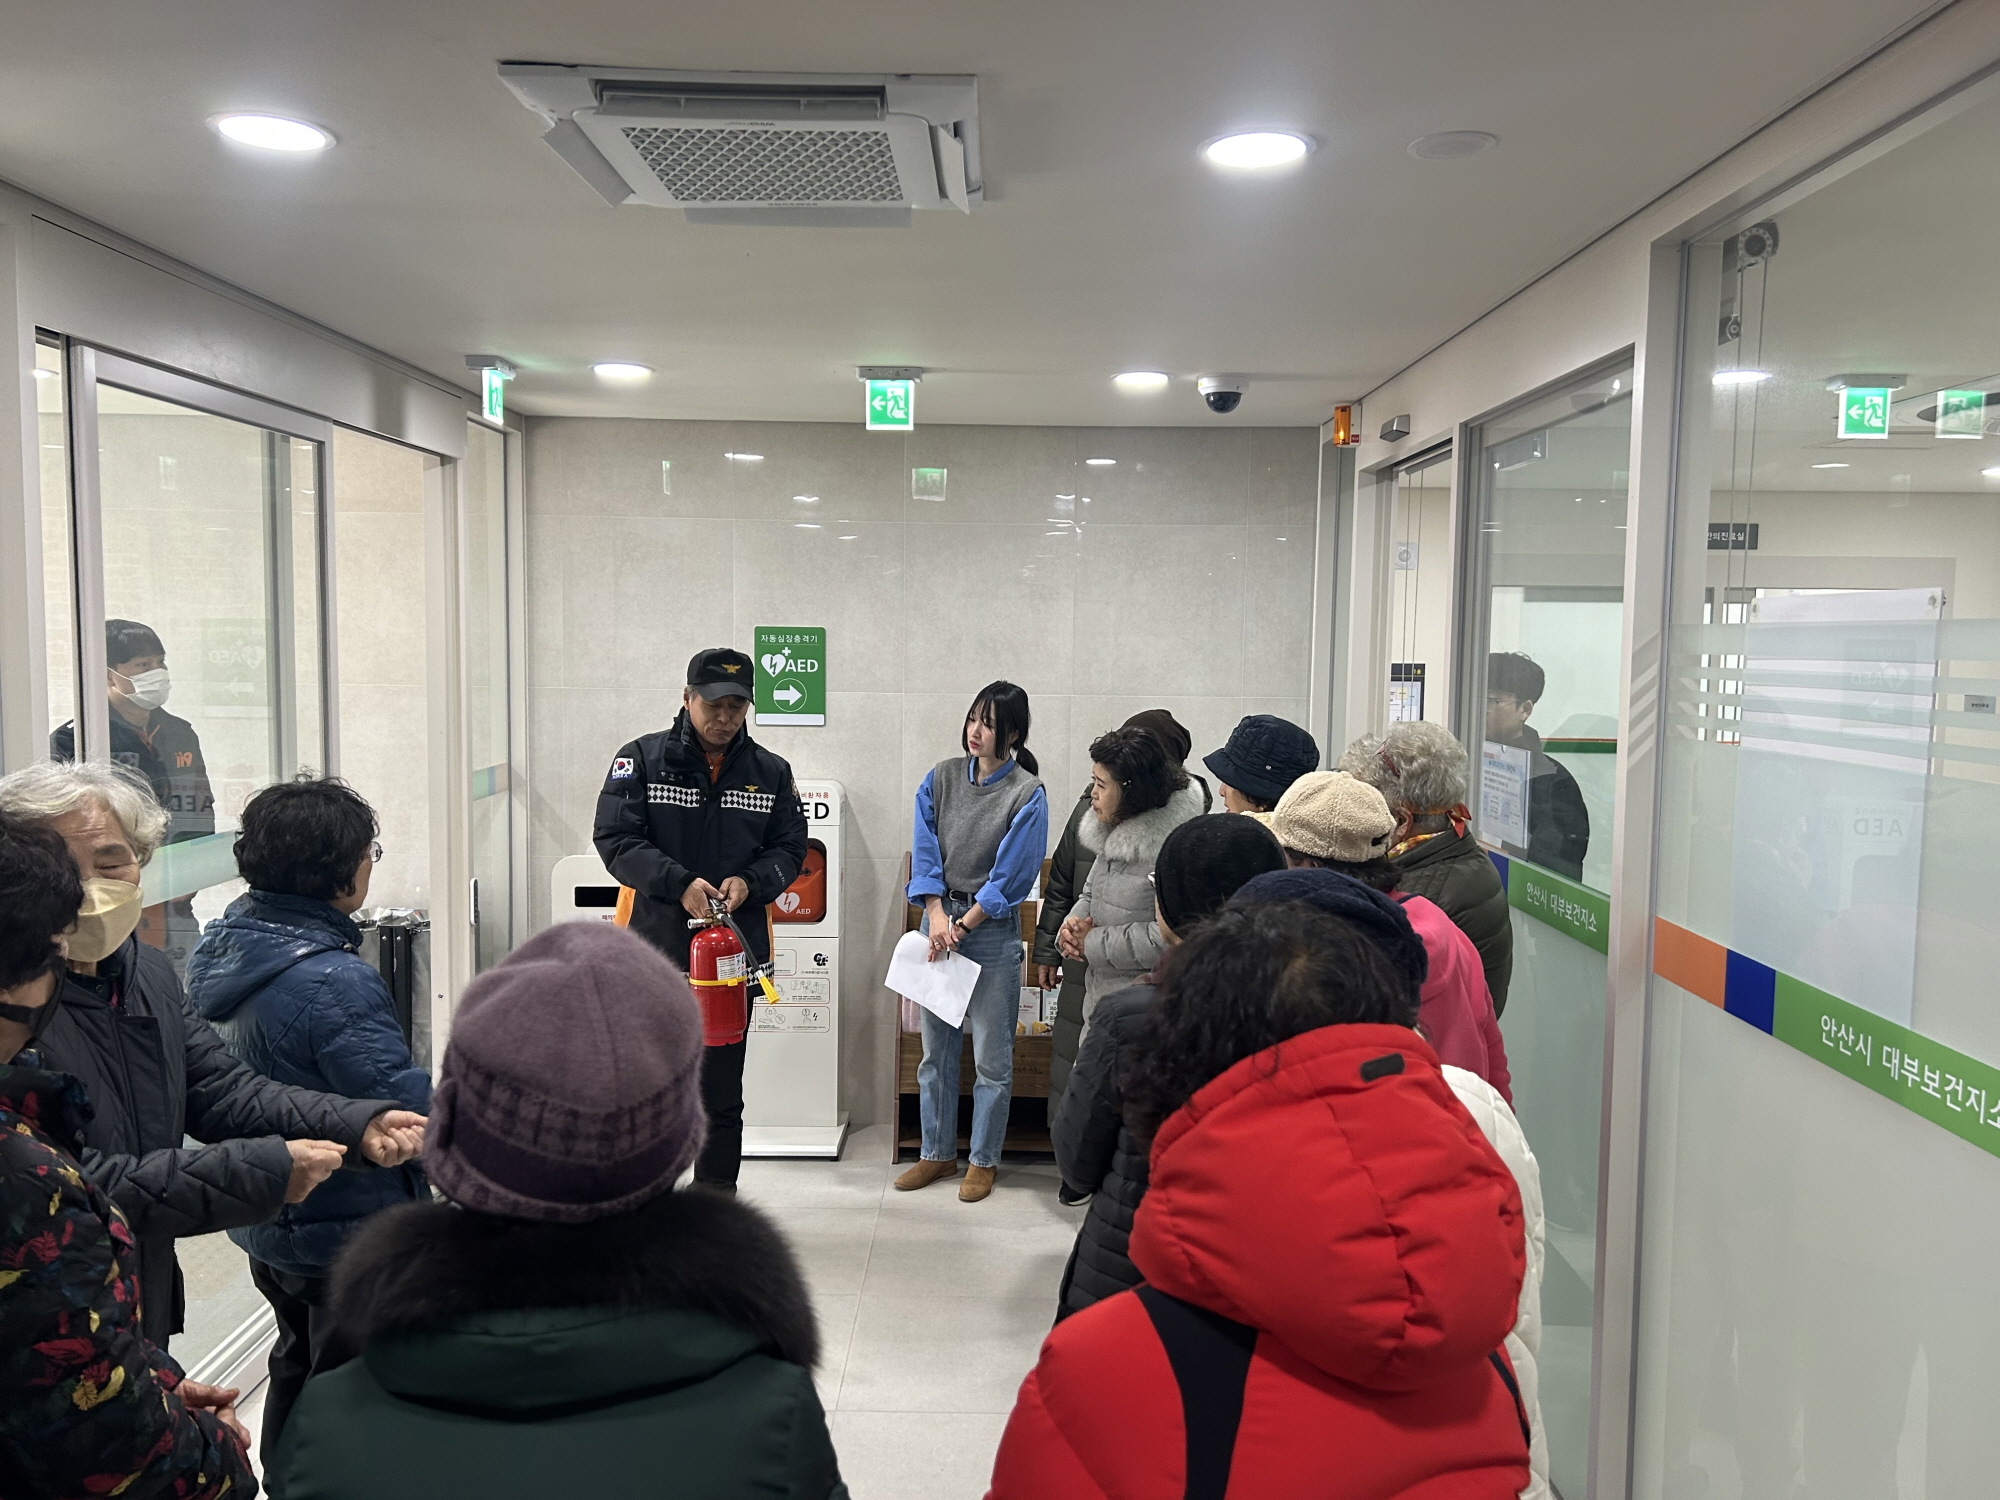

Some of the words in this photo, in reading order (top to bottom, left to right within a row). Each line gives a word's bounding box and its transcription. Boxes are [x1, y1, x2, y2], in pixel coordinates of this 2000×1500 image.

[760, 634, 818, 643] 자동심장충격기
[785, 659, 818, 673] AED
[175, 751, 193, 769] 119
[801, 791, 830, 799] 비환자용
[801, 802, 830, 820] ED
[1526, 882, 1548, 910] 안산시
[1550, 894, 1598, 933] 대부보건지소
[1820, 1014, 1873, 1067] 안산시
[1882, 1045, 2000, 1131] 대부보건지소
